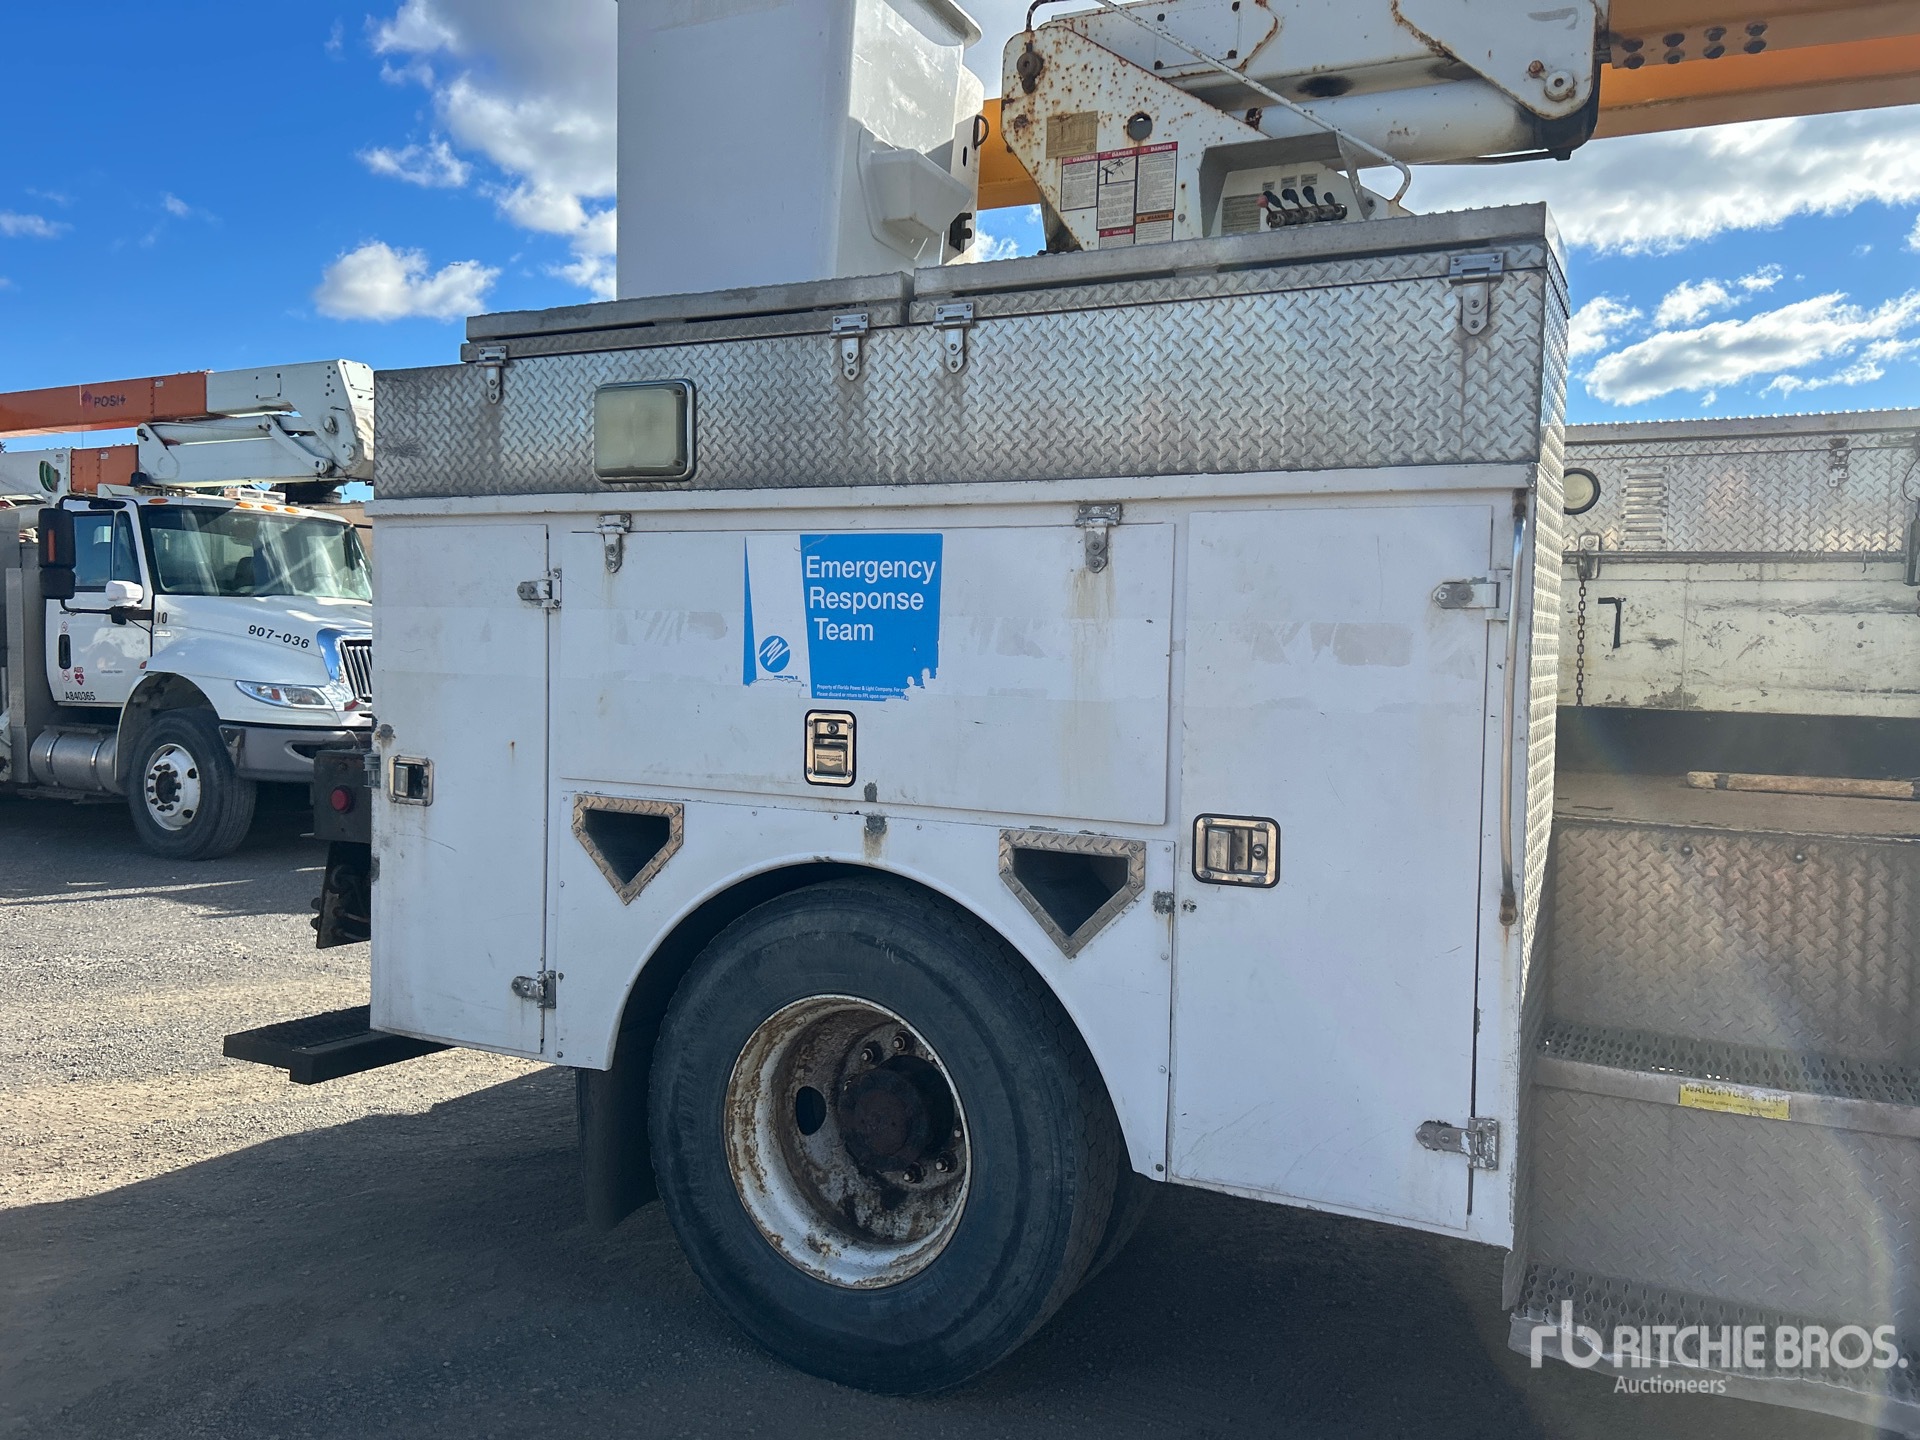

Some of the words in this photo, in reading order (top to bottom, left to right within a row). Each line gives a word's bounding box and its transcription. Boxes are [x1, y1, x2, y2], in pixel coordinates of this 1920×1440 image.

[1111, 149, 1133, 157] DANGER
[1150, 143, 1173, 152] DANGER
[805, 555, 937, 584] Emergency
[809, 586, 924, 615] Response
[157, 611, 168, 624] 10
[248, 624, 310, 649] 907-036
[813, 617, 874, 641] Team
[65, 691, 96, 701] A840365
